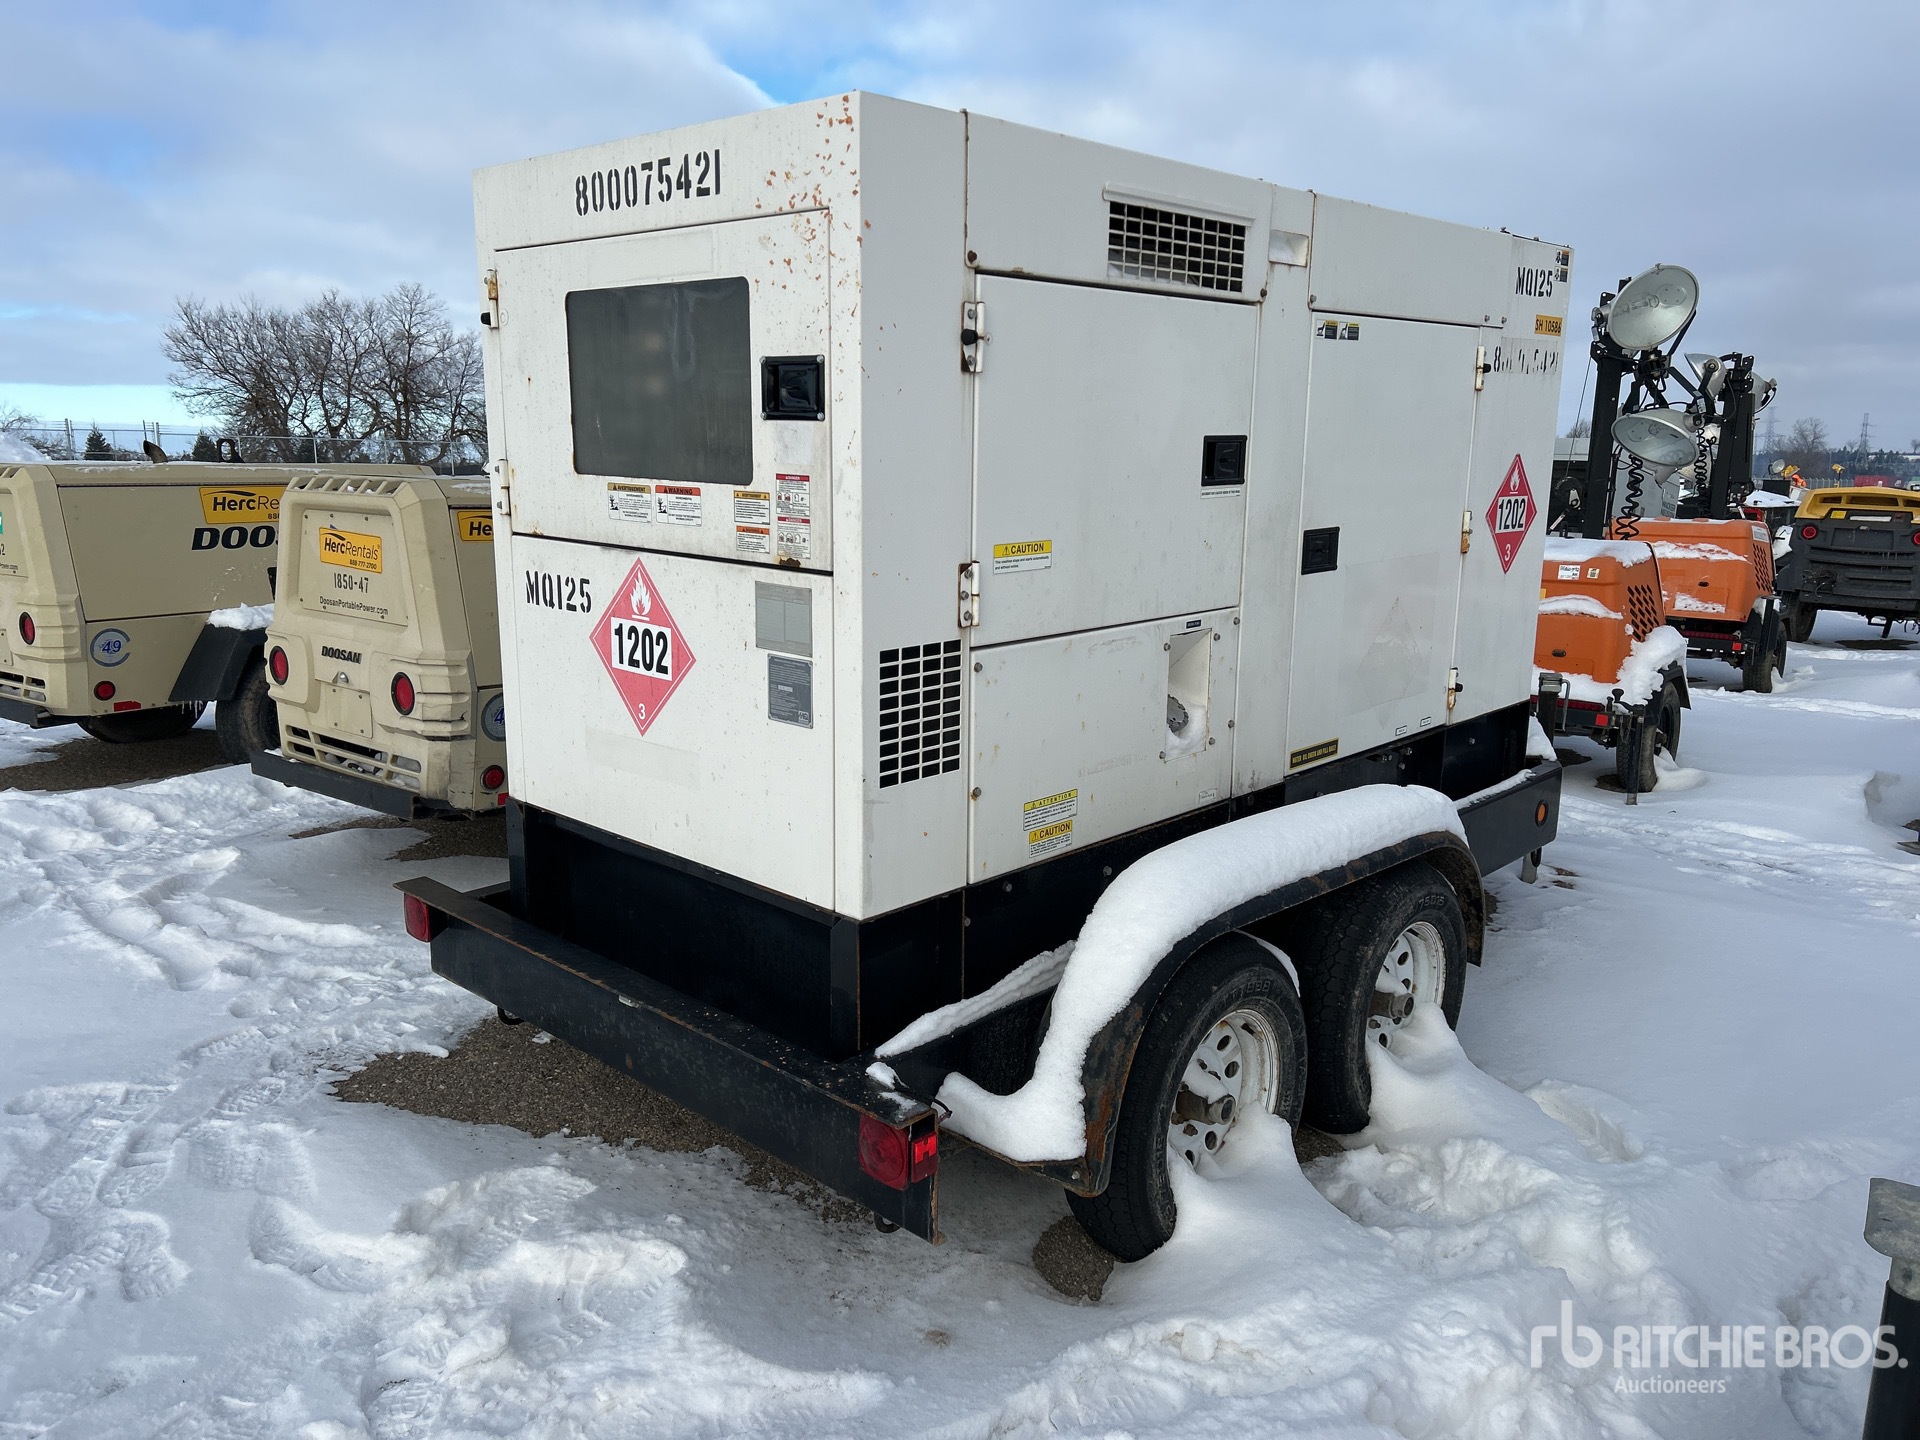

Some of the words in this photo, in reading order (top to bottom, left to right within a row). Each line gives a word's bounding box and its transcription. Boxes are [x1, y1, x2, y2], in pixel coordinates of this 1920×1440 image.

[575, 149, 720, 216] 800075421
[1535, 319, 1543, 332] SH
[1545, 320, 1562, 334] 10586
[1498, 498, 1526, 531] 1202
[192, 525, 279, 550] DOO
[1010, 543, 1044, 555] CAUTION
[1504, 543, 1511, 561] 3
[349, 559, 377, 570] 888-777-2700
[334, 572, 369, 593] 1850-47
[526, 570, 592, 614] MQ125
[320, 596, 389, 615] DoosanPortablePower.com
[102, 640, 122, 654] 49
[321, 645, 362, 664] DOOSAN
[614, 622, 669, 675] 1202
[638, 703, 646, 720] 3
[1039, 792, 1072, 806] ATTENTION
[1040, 822, 1070, 838] CAUTION
